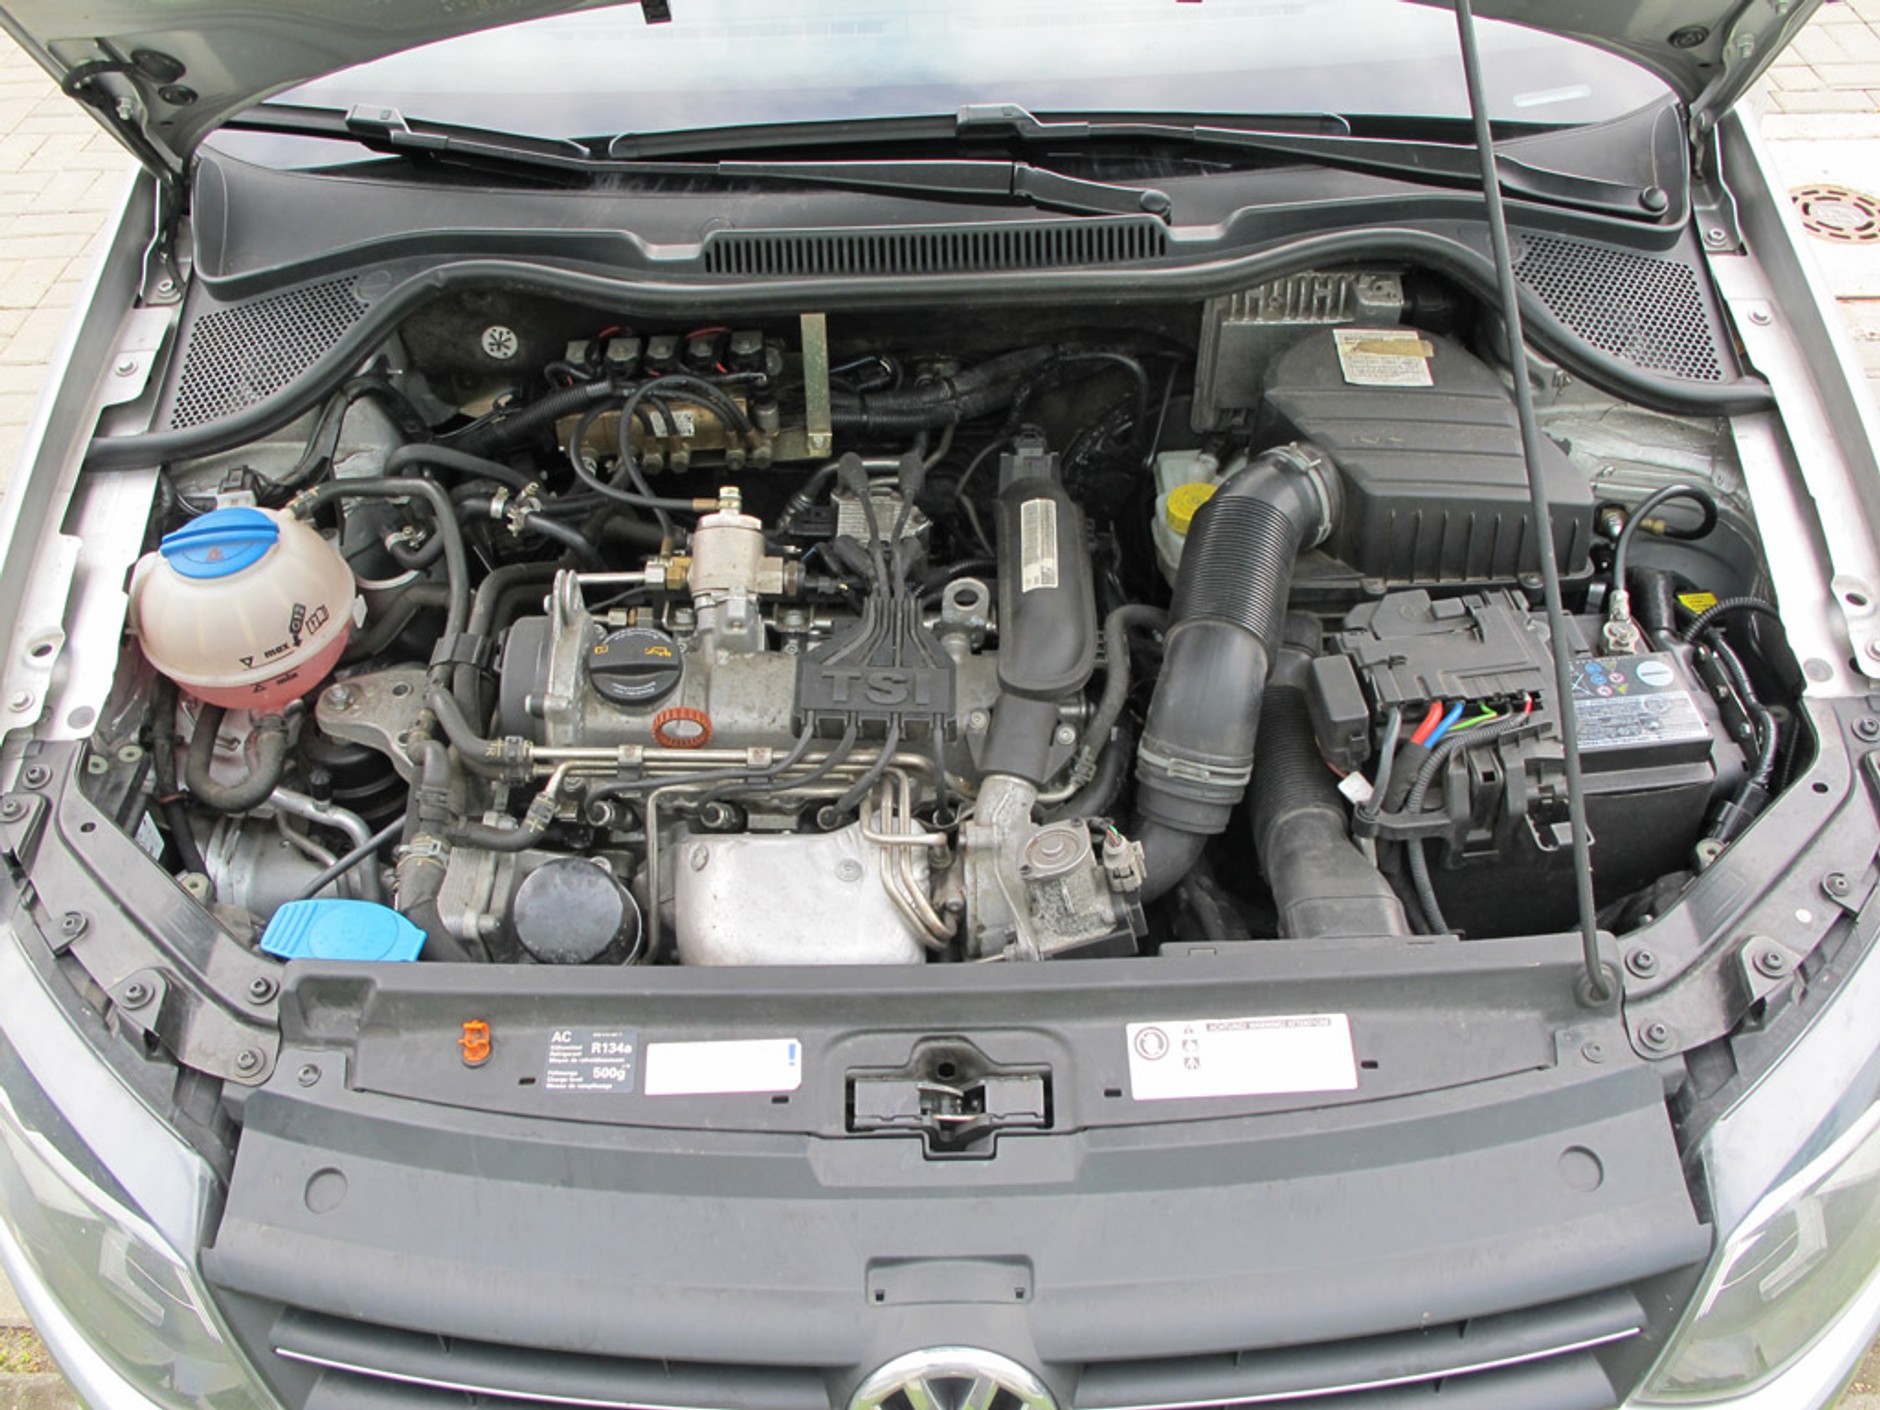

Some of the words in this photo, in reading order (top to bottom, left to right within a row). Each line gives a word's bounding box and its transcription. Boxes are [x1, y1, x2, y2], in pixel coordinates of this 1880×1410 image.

[264, 642, 289, 658] max
[821, 670, 930, 705] TSI
[551, 1030, 572, 1043] AC
[591, 1041, 633, 1054] R134a
[592, 1066, 626, 1082] 500g
